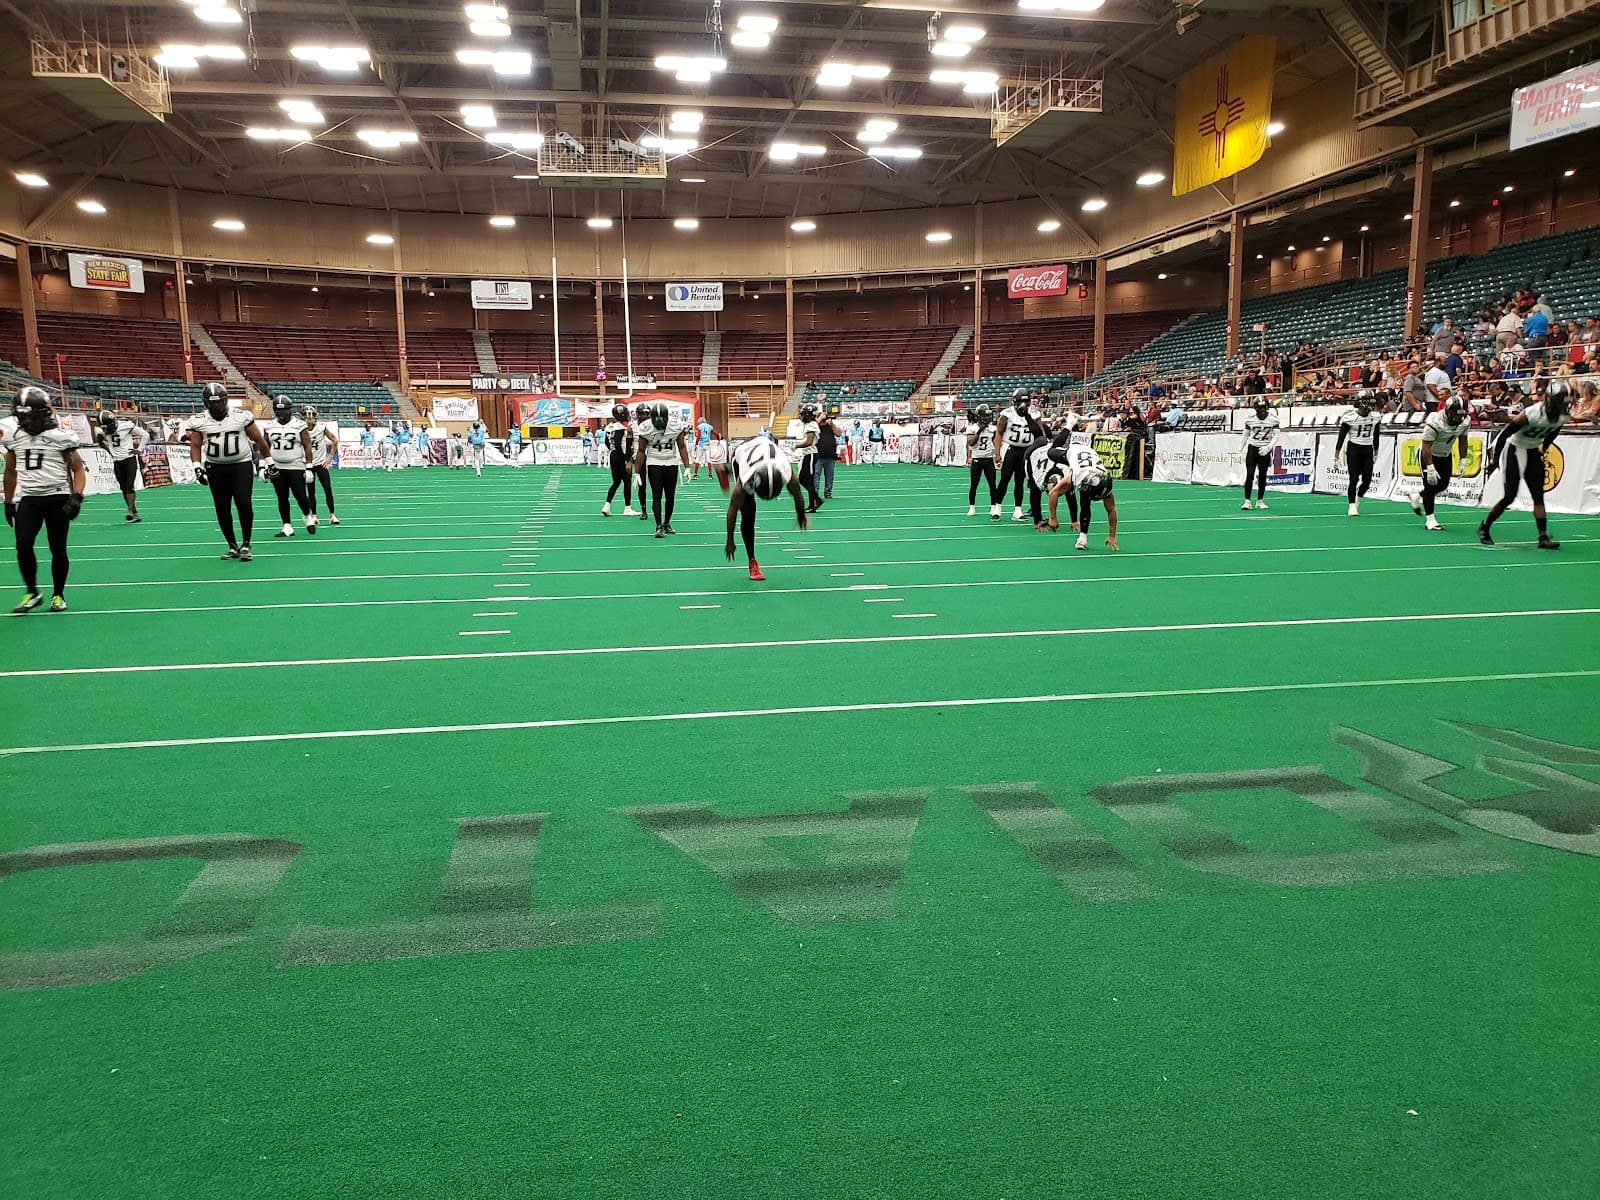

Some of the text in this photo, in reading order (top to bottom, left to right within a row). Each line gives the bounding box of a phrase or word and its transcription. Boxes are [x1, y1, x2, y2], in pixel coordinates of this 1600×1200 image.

[87, 268, 128, 282] STATE FAIR
[690, 285, 719, 294] United
[1078, 284, 1088, 300] B
[690, 293, 721, 301] Rentals
[596, 371, 607, 380] 25
[472, 378, 530, 390] PARTY DECK
[1252, 426, 1272, 441] 22
[206, 431, 240, 458] 60
[272, 432, 296, 450] 33
[650, 439, 673, 452] 44
